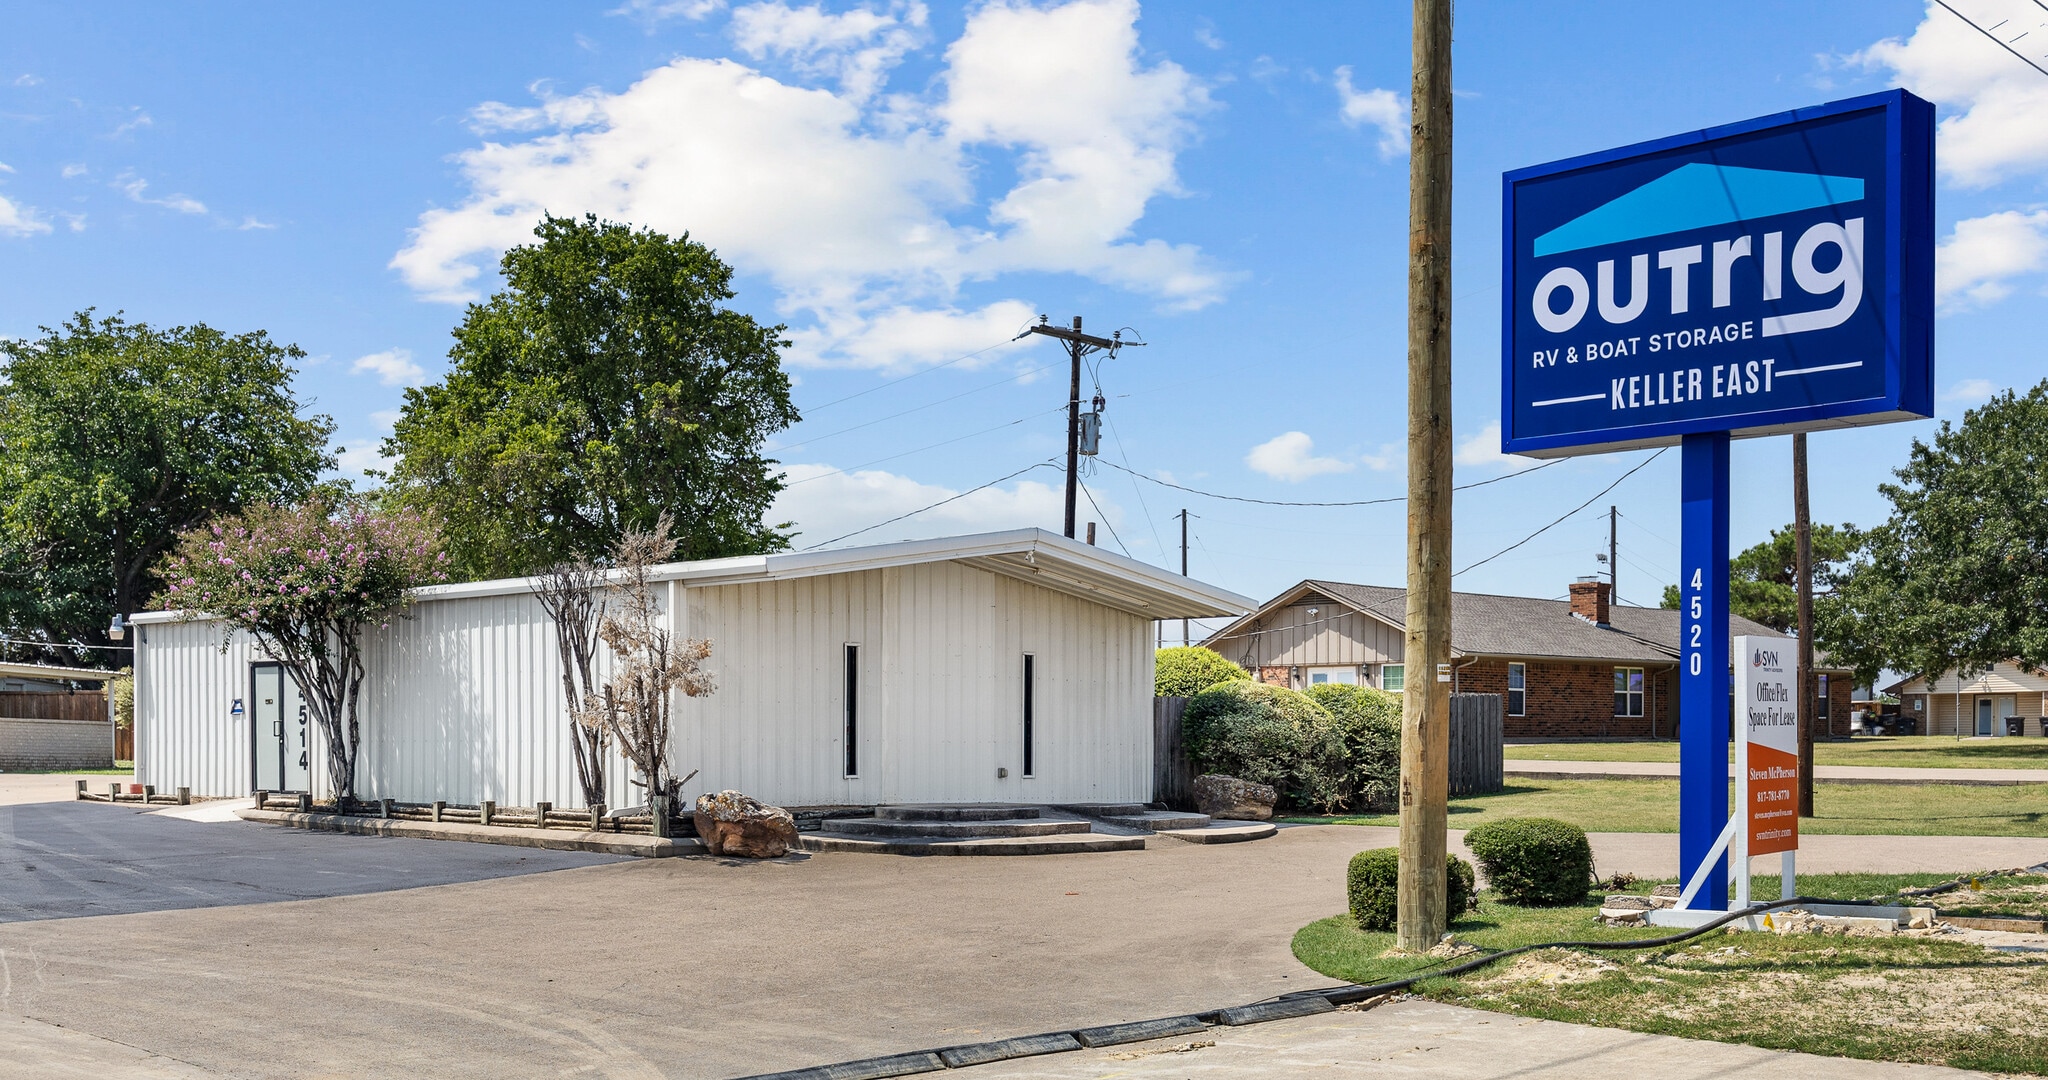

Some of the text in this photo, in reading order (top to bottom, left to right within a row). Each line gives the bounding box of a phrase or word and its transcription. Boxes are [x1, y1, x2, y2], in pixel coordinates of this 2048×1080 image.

[1533, 321, 1754, 369] RV & BOAT STORAGE
[1611, 358, 1775, 411] KELLER EAST
[1690, 568, 1703, 676] 4520
[1762, 650, 1778, 667] SVN
[1748, 706, 1795, 732] Space For Lease
[1749, 766, 1796, 781] Steven McPherson
[1757, 789, 1790, 803] 817-781-8770
[1756, 828, 1792, 841] svntrinity.com
